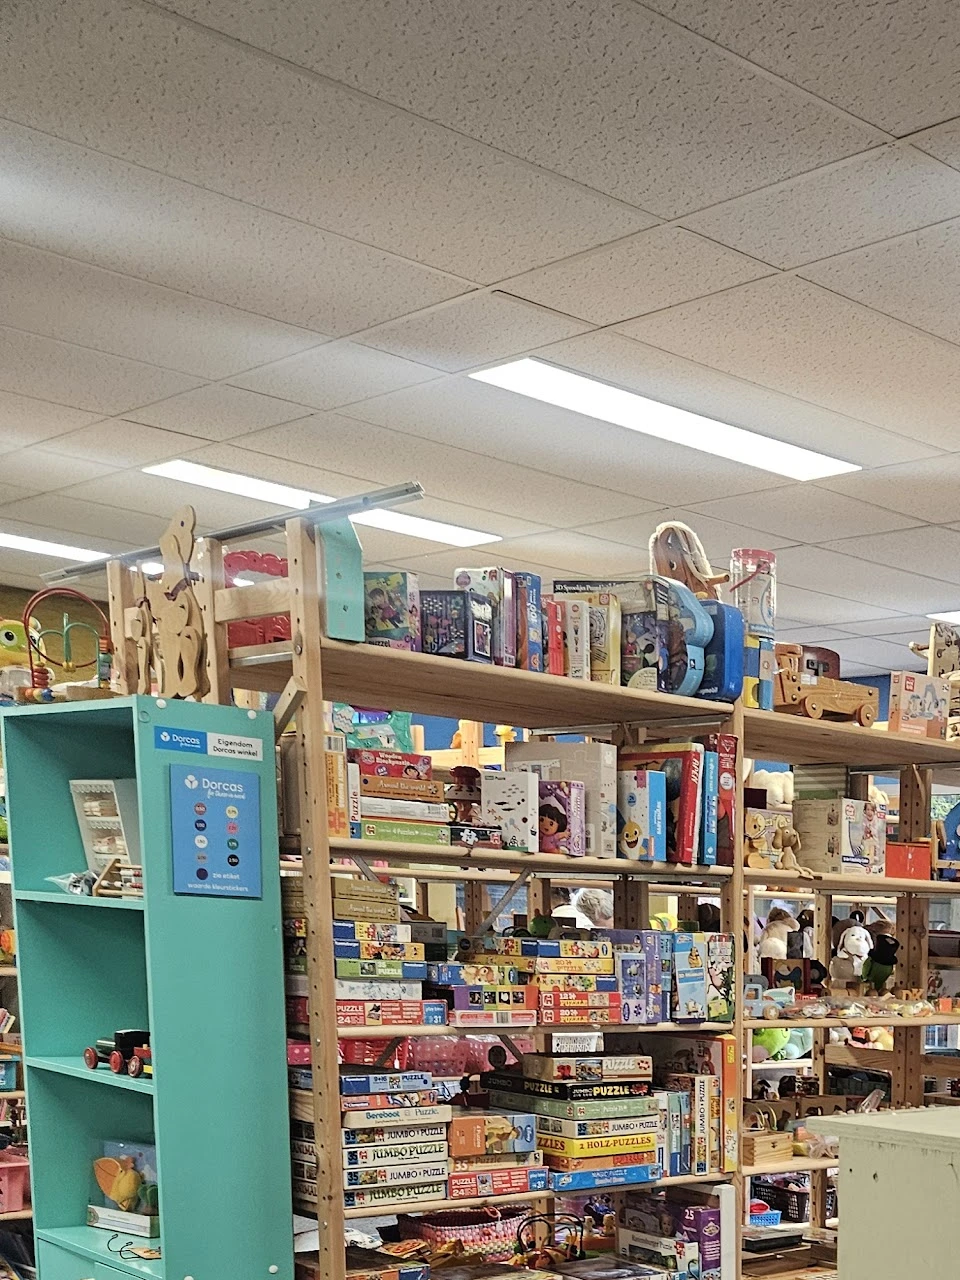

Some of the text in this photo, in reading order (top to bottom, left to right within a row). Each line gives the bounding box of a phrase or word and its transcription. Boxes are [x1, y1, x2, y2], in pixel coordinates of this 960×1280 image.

[172, 734, 201, 745] Dorcas
[217, 738, 253, 749] Eigendom
[213, 745, 258, 757] Dorcas winkel
[691, 758, 700, 785] APEN
[202, 778, 243, 793] Dorcas
[378, 780, 399, 789] Around
[410, 784, 426, 792] world
[351, 791, 359, 822] Puzzle
[187, 882, 212, 890] waarde
[337, 1016, 351, 1024] 24
[603, 1059, 635, 1071] PUZZLE
[401, 1074, 424, 1082] PUZZLE
[524, 1083, 553, 1094] PUZZLE
[593, 1086, 630, 1097] PUZZLE
[577, 1120, 658, 1132] 35 JUMBO PUZZLE
[345, 1126, 444, 1140] 35 JUMBO PUZZLE
[587, 1136, 651, 1150] HOLZ-PUZZLES
[347, 1143, 444, 1162] 35 JUMBO PUZZLE
[454, 1156, 502, 1171] 35 Puzzle
[347, 1167, 446, 1181] 35 JUMBO PUZZLE
[451, 1178, 476, 1186] PUZZLE
[344, 1192, 355, 1203] 35
[369, 1188, 405, 1202] JUMBO
[406, 1184, 442, 1196] PUZZLE
[452, 1188, 465, 1196] 24
[684, 1209, 695, 1220] 25
